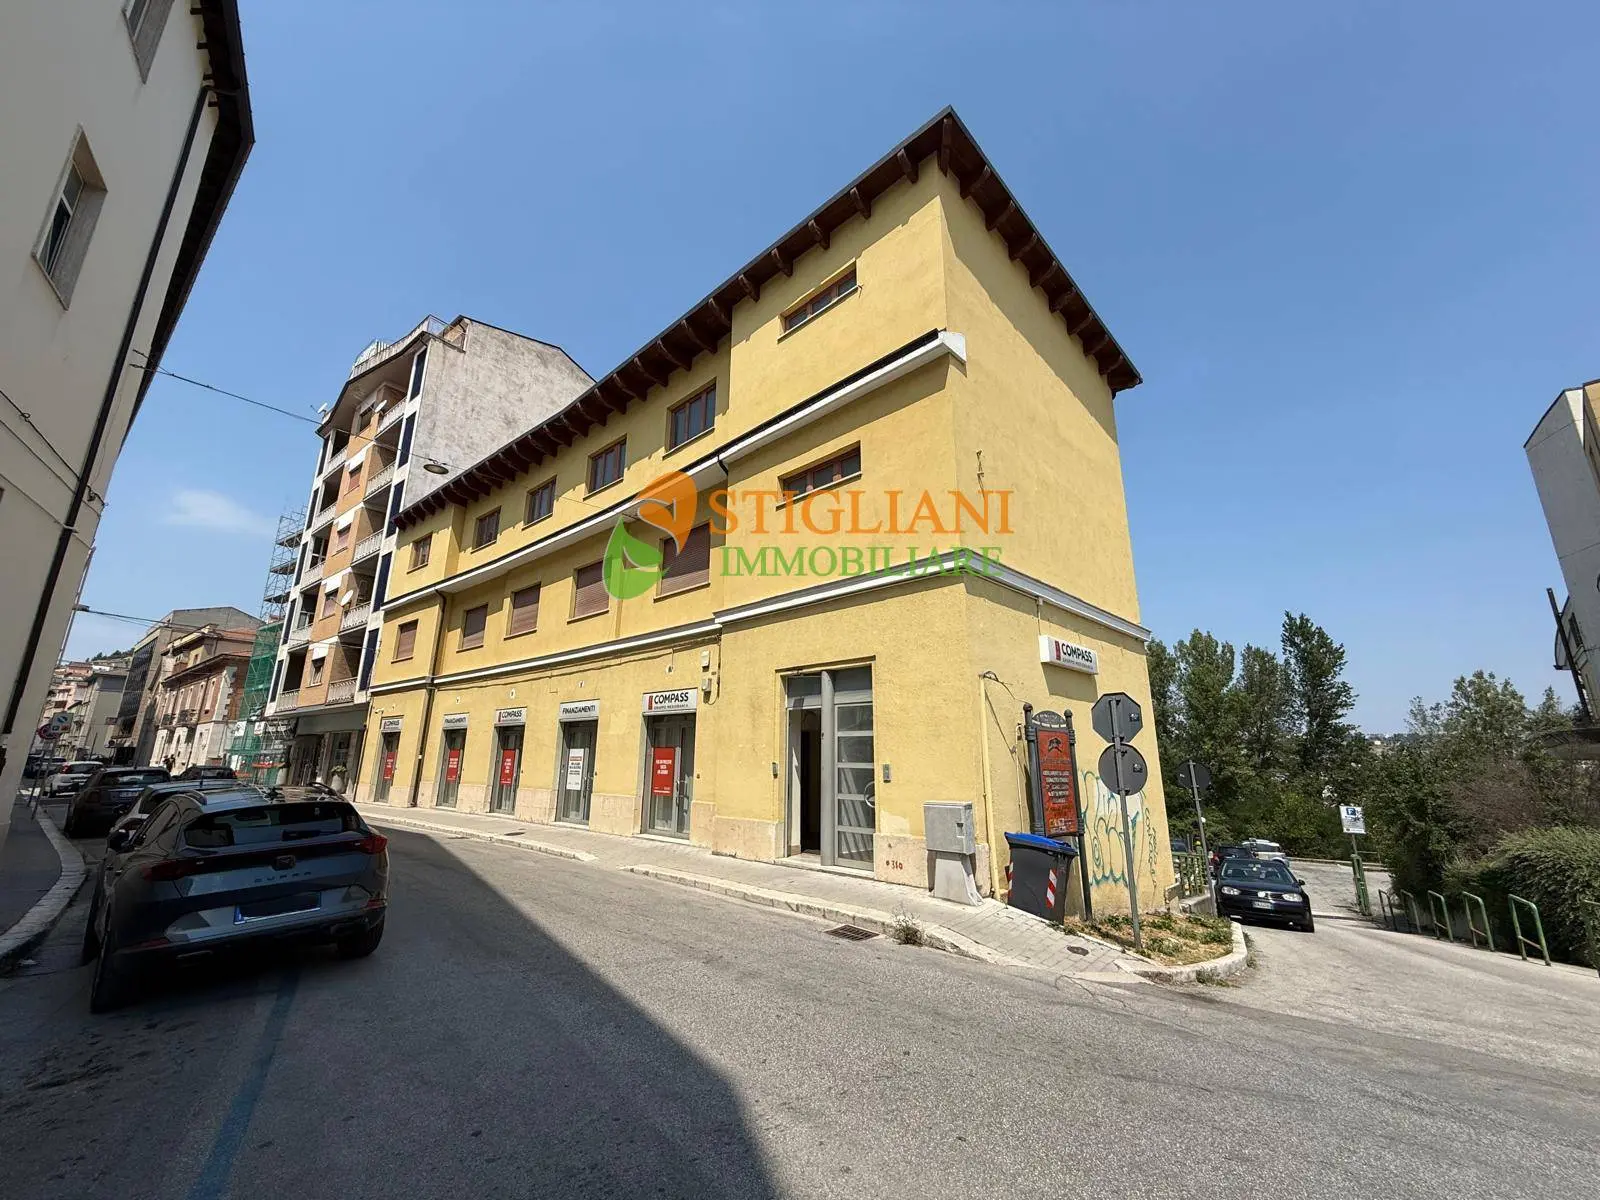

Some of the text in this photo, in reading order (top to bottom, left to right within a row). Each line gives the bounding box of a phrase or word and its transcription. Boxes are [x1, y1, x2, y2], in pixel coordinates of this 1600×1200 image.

[1061, 643, 1092, 663] COMPASS
[653, 691, 689, 704] COMPASS
[501, 709, 523, 719] COMPASS
[562, 704, 596, 714] FINANZIAMENTI
